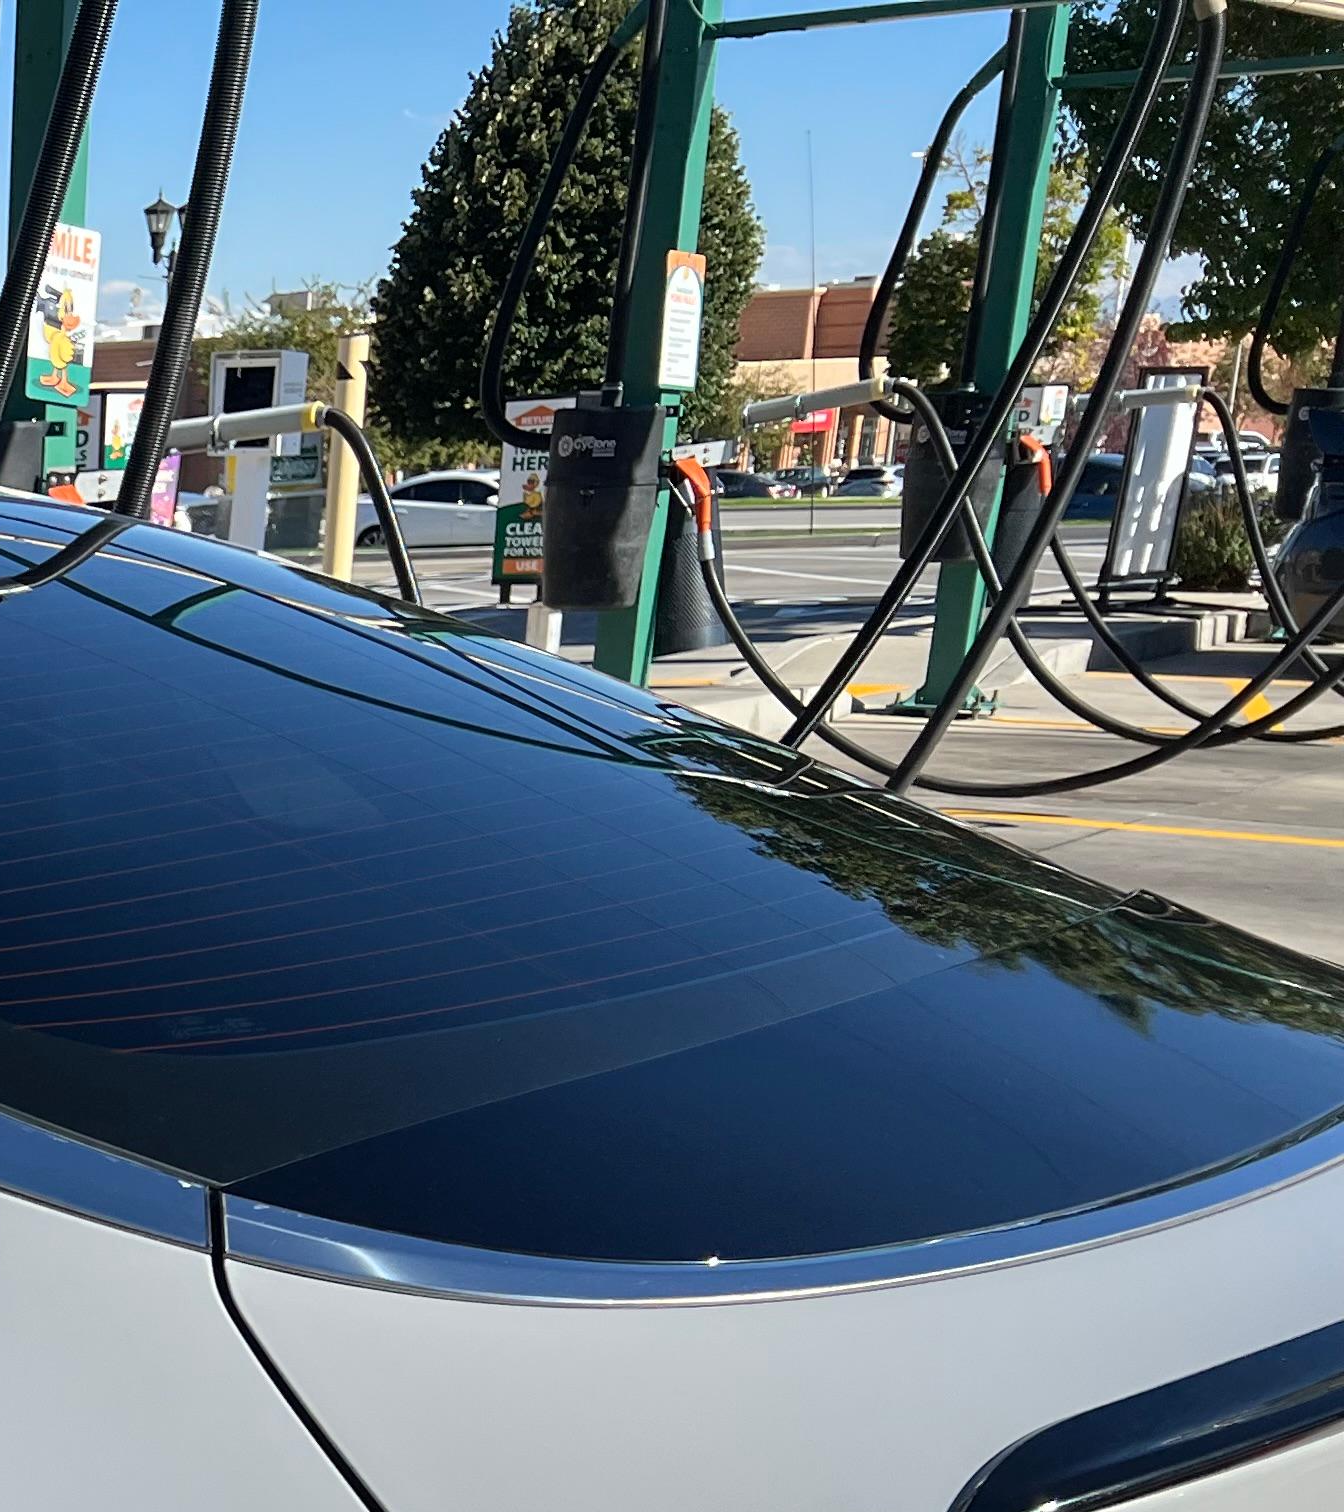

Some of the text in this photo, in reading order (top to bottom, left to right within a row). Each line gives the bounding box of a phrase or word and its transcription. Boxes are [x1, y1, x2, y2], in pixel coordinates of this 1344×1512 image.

[50, 231, 97, 269] MILE,
[513, 456, 549, 471] HER
[506, 522, 543, 536] CLEA
[503, 547, 523, 557] FOR
